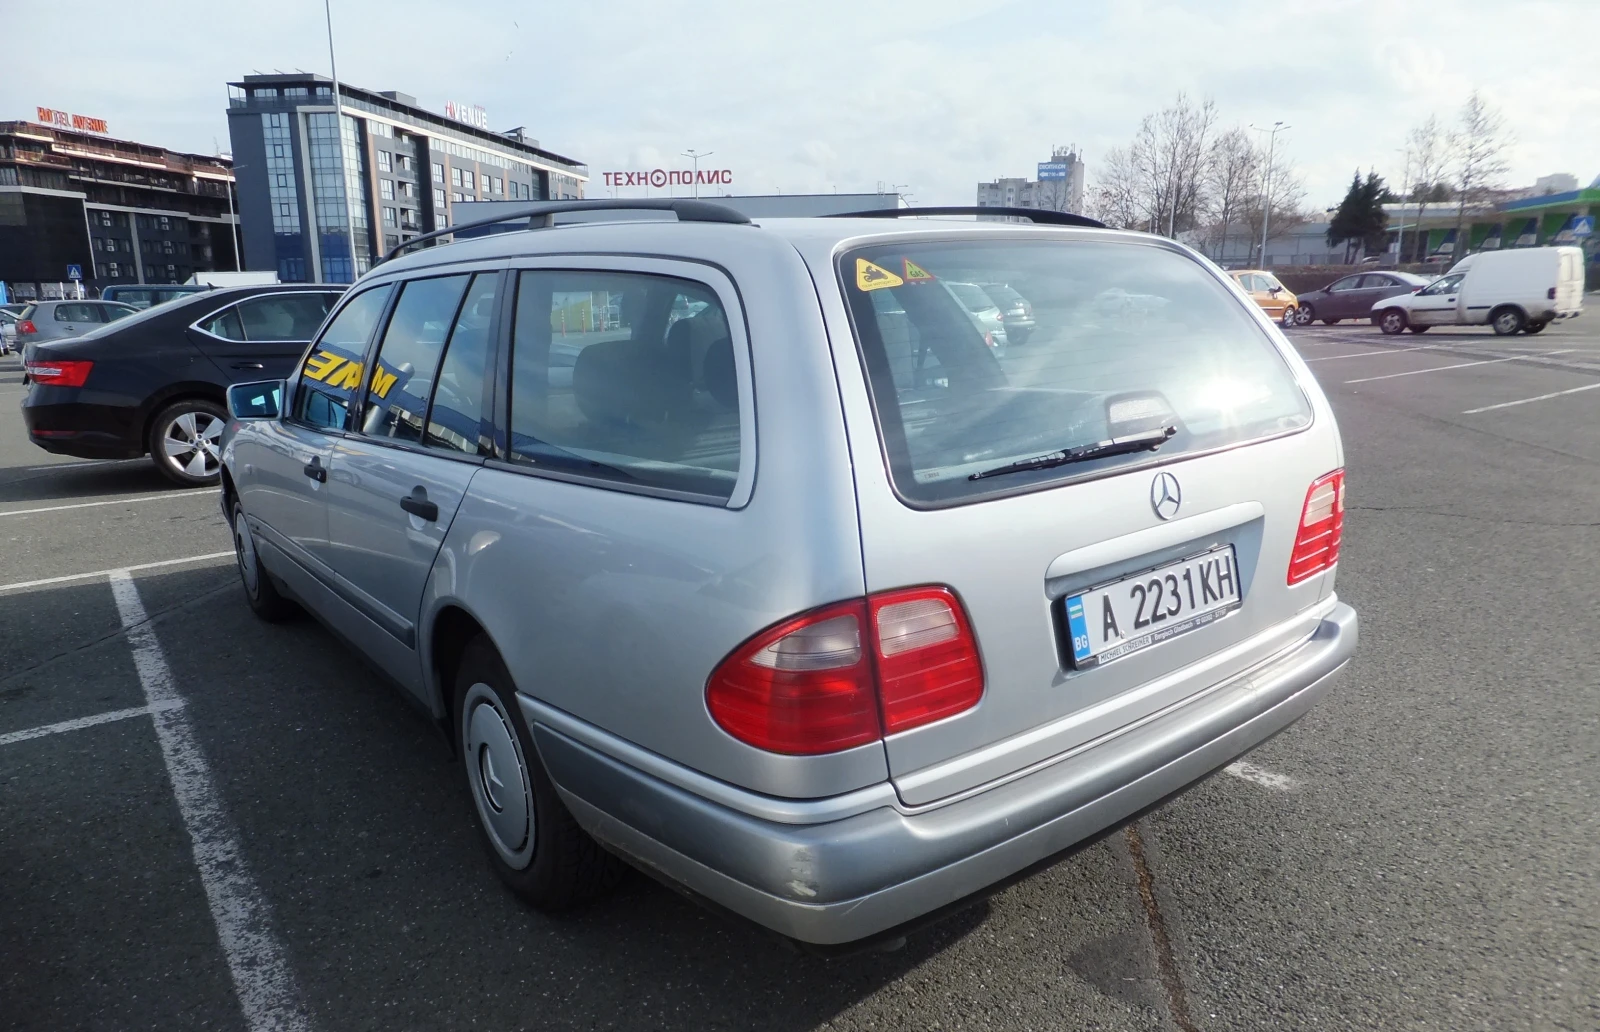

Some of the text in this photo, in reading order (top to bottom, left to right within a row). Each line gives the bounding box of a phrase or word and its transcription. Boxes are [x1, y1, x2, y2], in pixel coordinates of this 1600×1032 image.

[37, 106, 109, 134] HOTEL AVENUE
[445, 99, 488, 130] AVENUE
[602, 168, 733, 188] ТЕХНОПОЛИС
[1102, 592, 1120, 643] A
[1129, 565, 1196, 631] 2231
[1073, 635, 1090, 652] BG
[1100, 647, 1122, 663] MICHAEL
